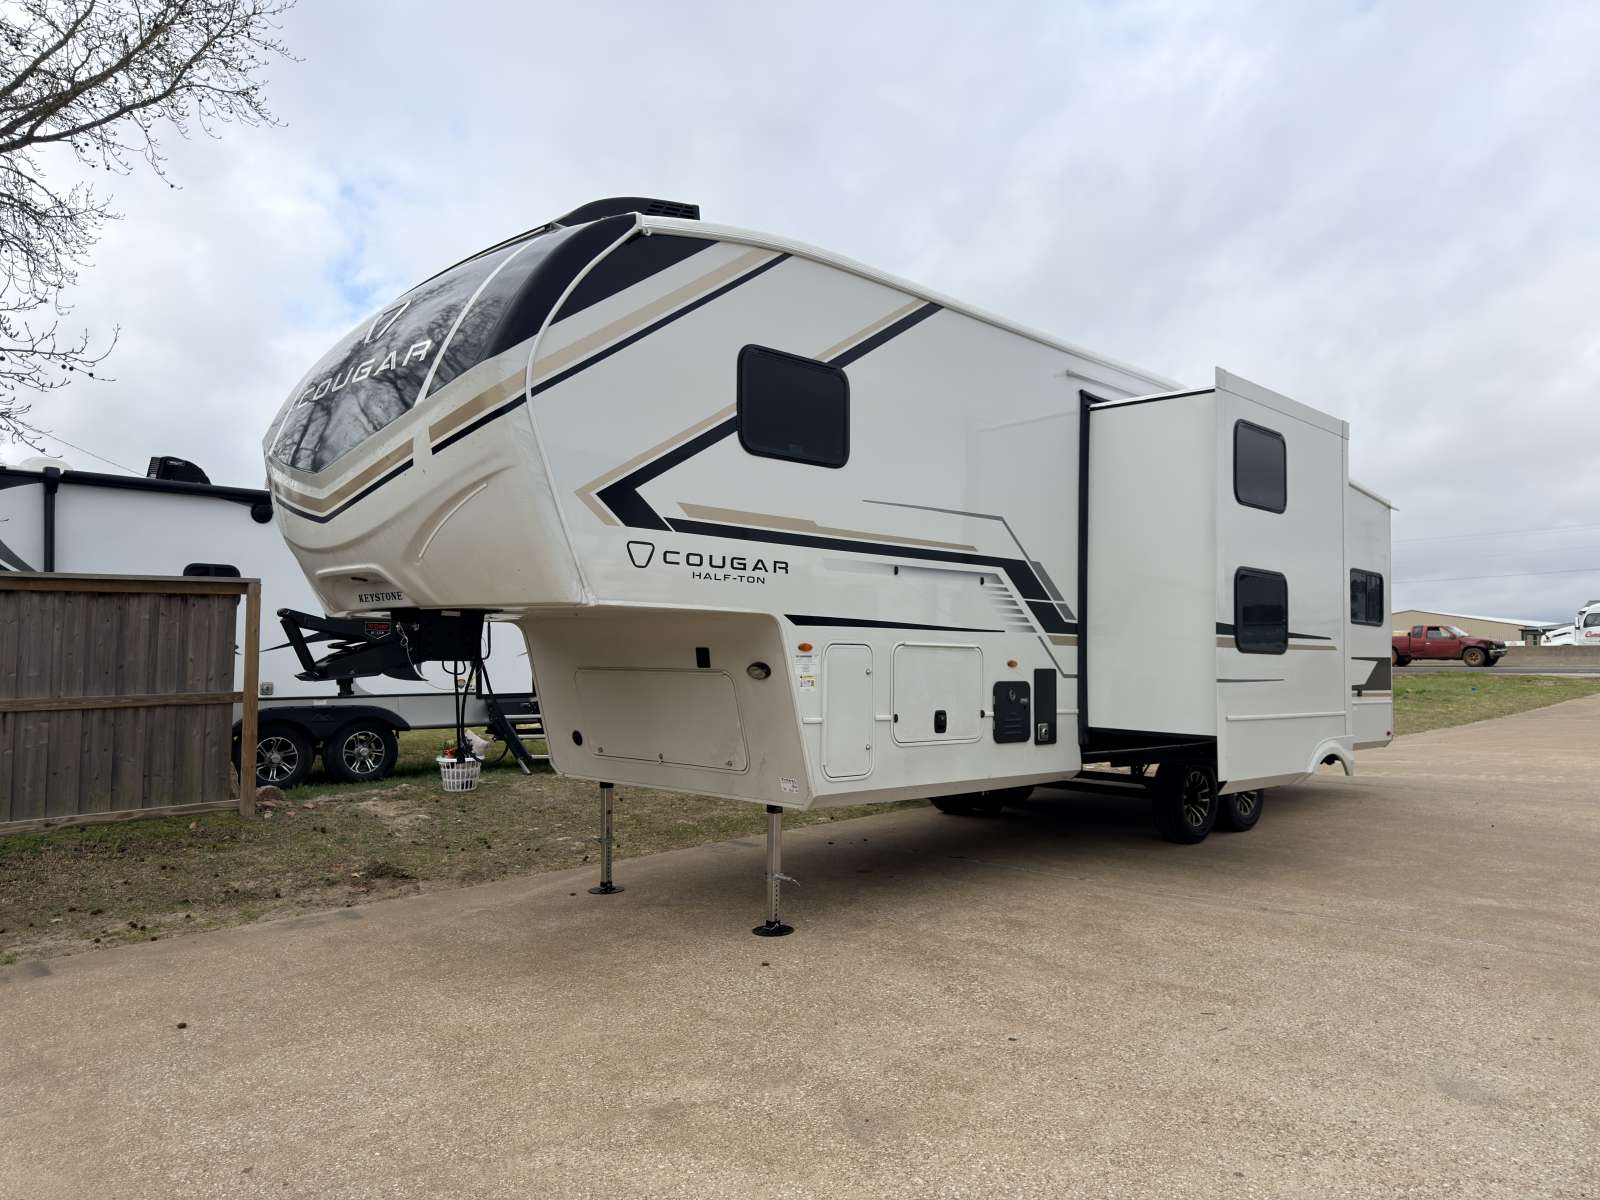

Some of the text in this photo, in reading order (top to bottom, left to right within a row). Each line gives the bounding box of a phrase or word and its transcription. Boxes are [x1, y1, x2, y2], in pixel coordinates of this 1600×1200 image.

[297, 340, 432, 409] COUGAR
[663, 550, 789, 574] COUGAR
[692, 572, 766, 584] HALF-TON
[358, 591, 403, 602] KEYSTONE
